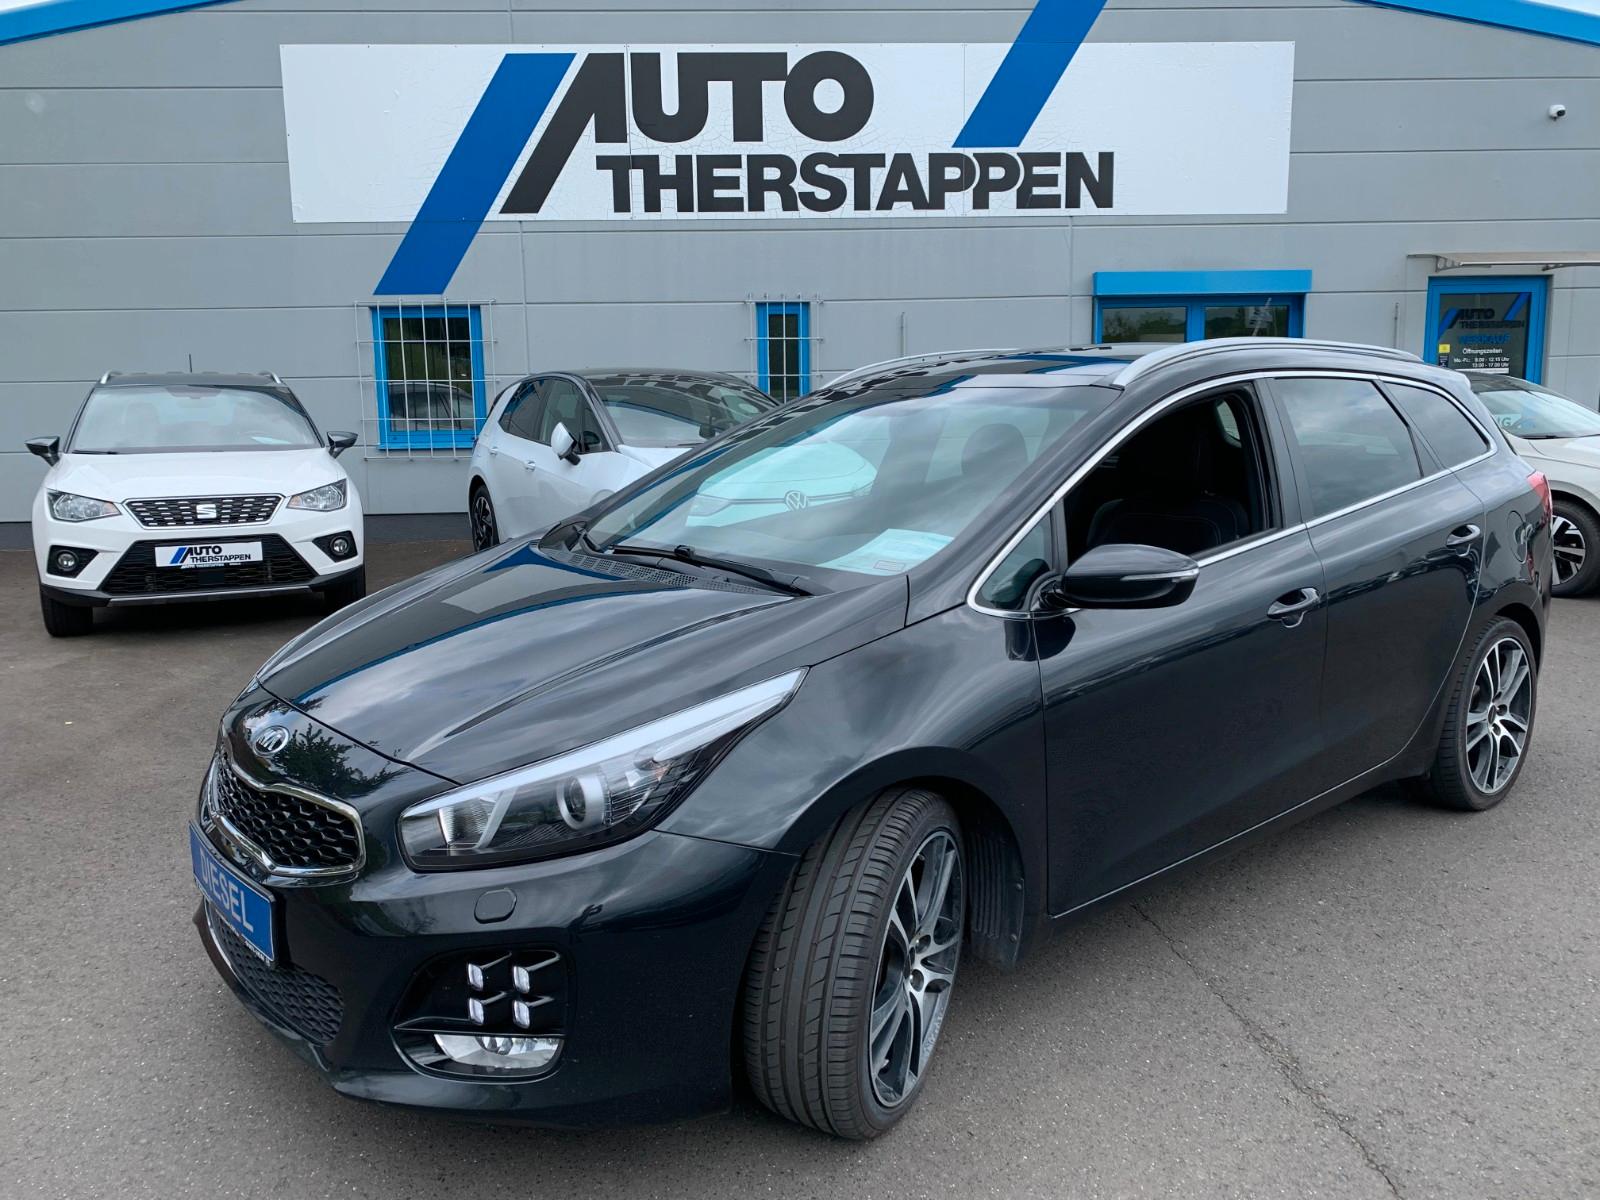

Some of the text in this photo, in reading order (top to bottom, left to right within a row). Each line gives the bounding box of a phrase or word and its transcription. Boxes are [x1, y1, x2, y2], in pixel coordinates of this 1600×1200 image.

[499, 50, 874, 214] AUTO
[595, 151, 1115, 213] THERSTAPPEN
[1448, 308, 1496, 329] AUTO
[179, 545, 223, 564] AUTO
[190, 554, 252, 563] THERSTAPPEN
[200, 850, 255, 934] DIESEL
